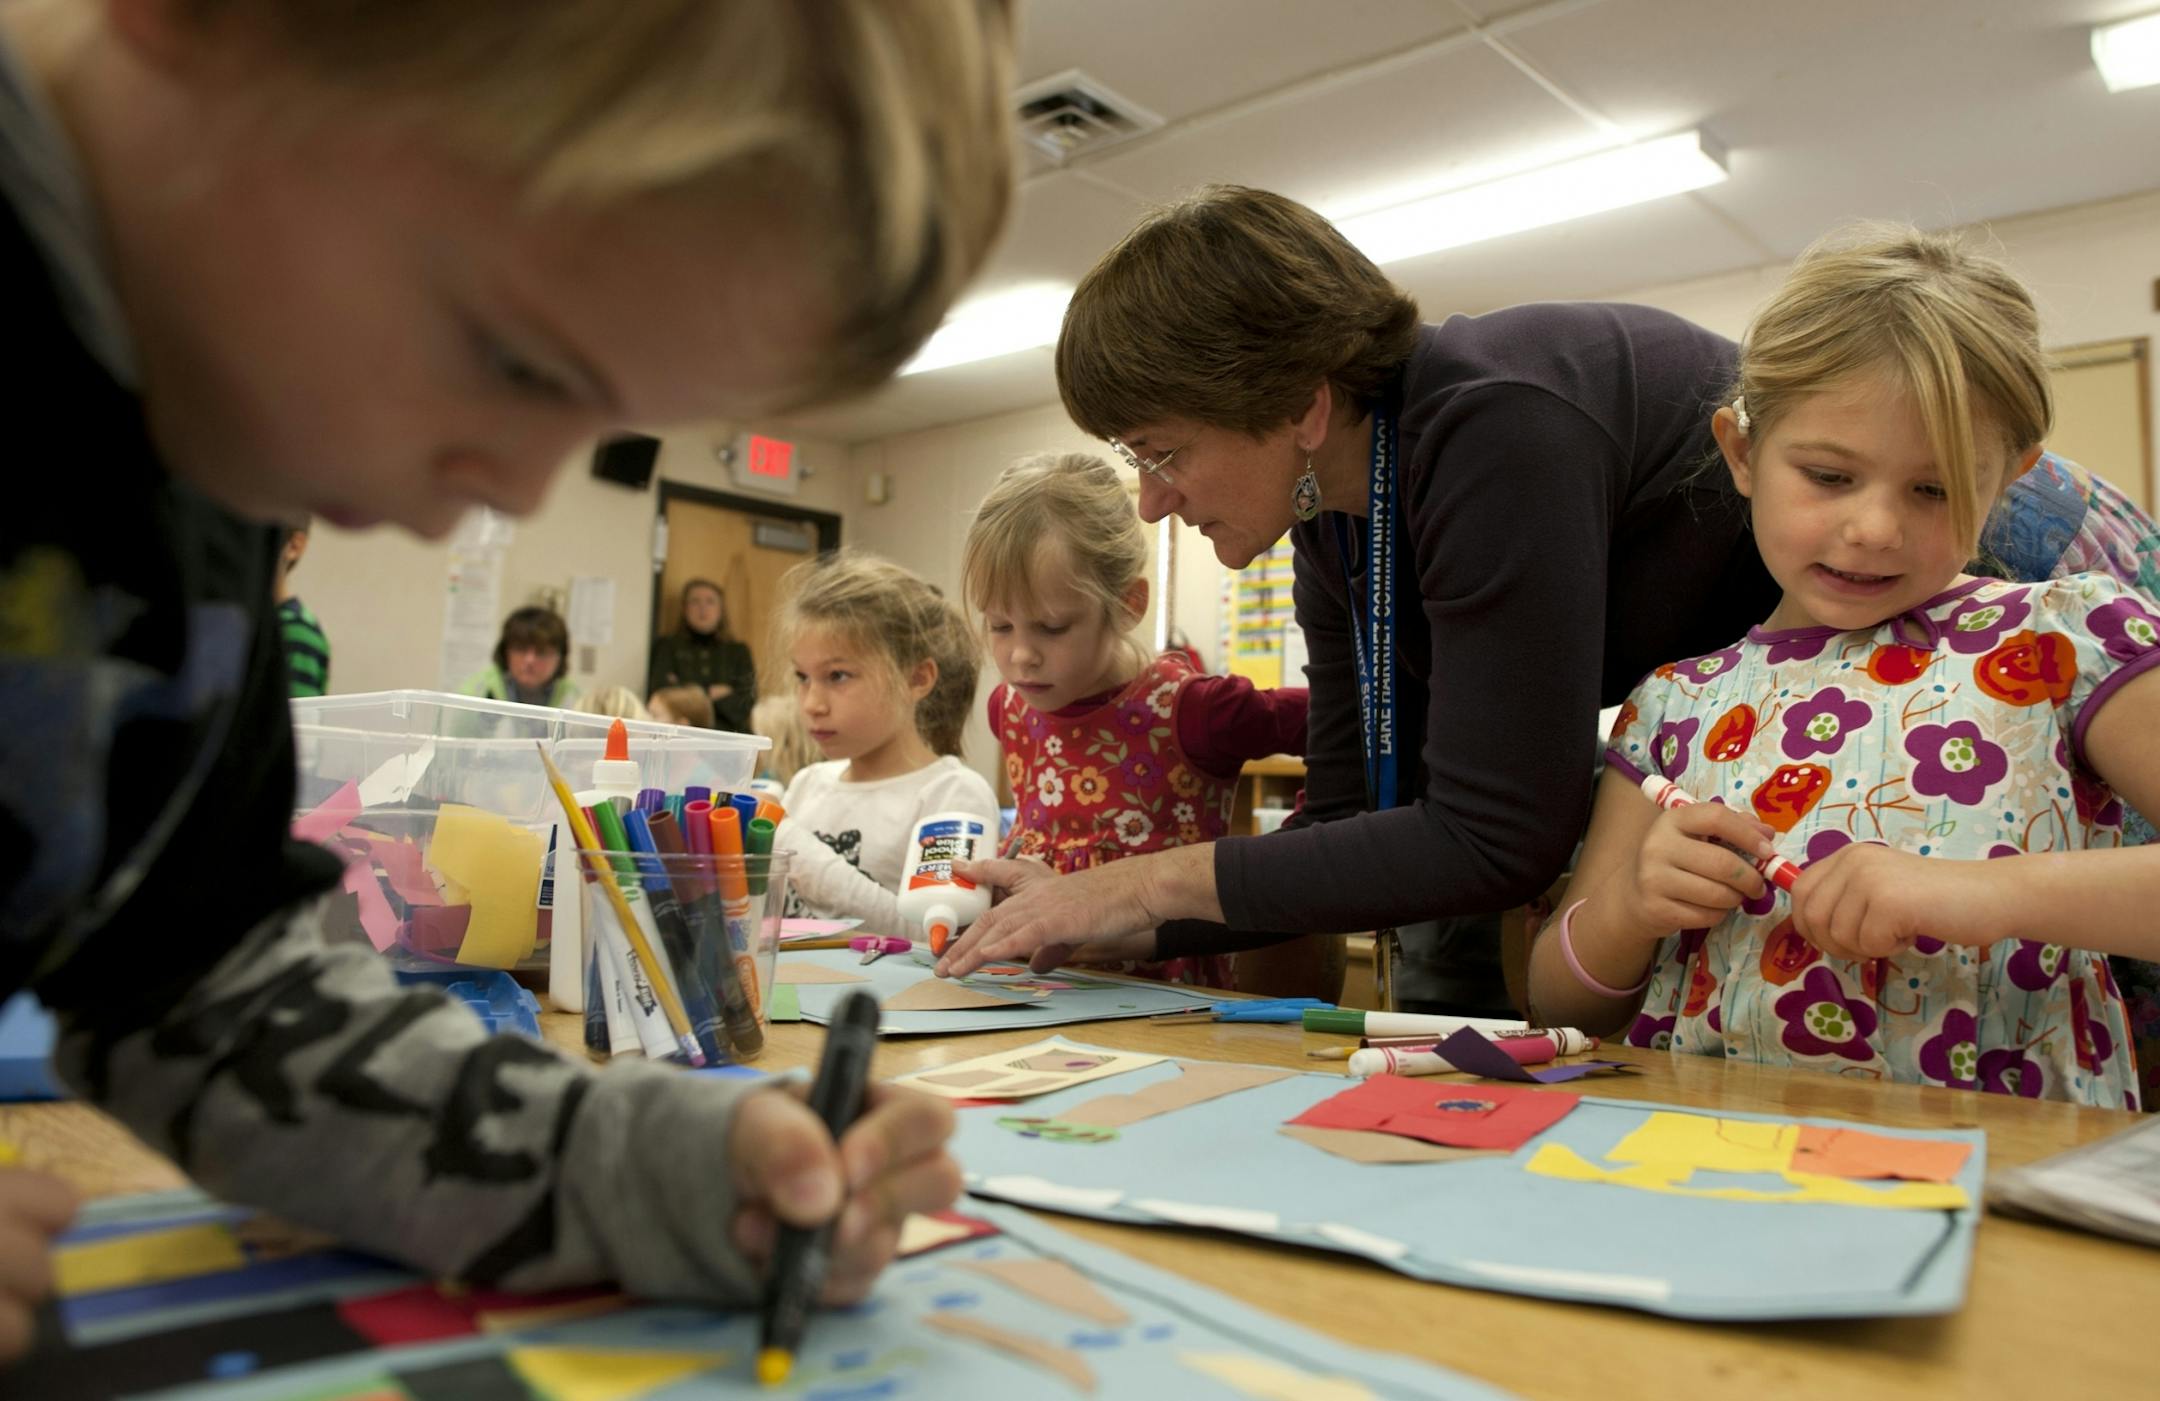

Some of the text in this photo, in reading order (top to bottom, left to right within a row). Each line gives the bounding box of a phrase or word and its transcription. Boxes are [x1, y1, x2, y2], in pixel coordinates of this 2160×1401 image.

[1373, 498, 1391, 617] COMMUNITY
[1373, 622, 1391, 704] HARRIET
[1374, 707, 1392, 755] LAKE
